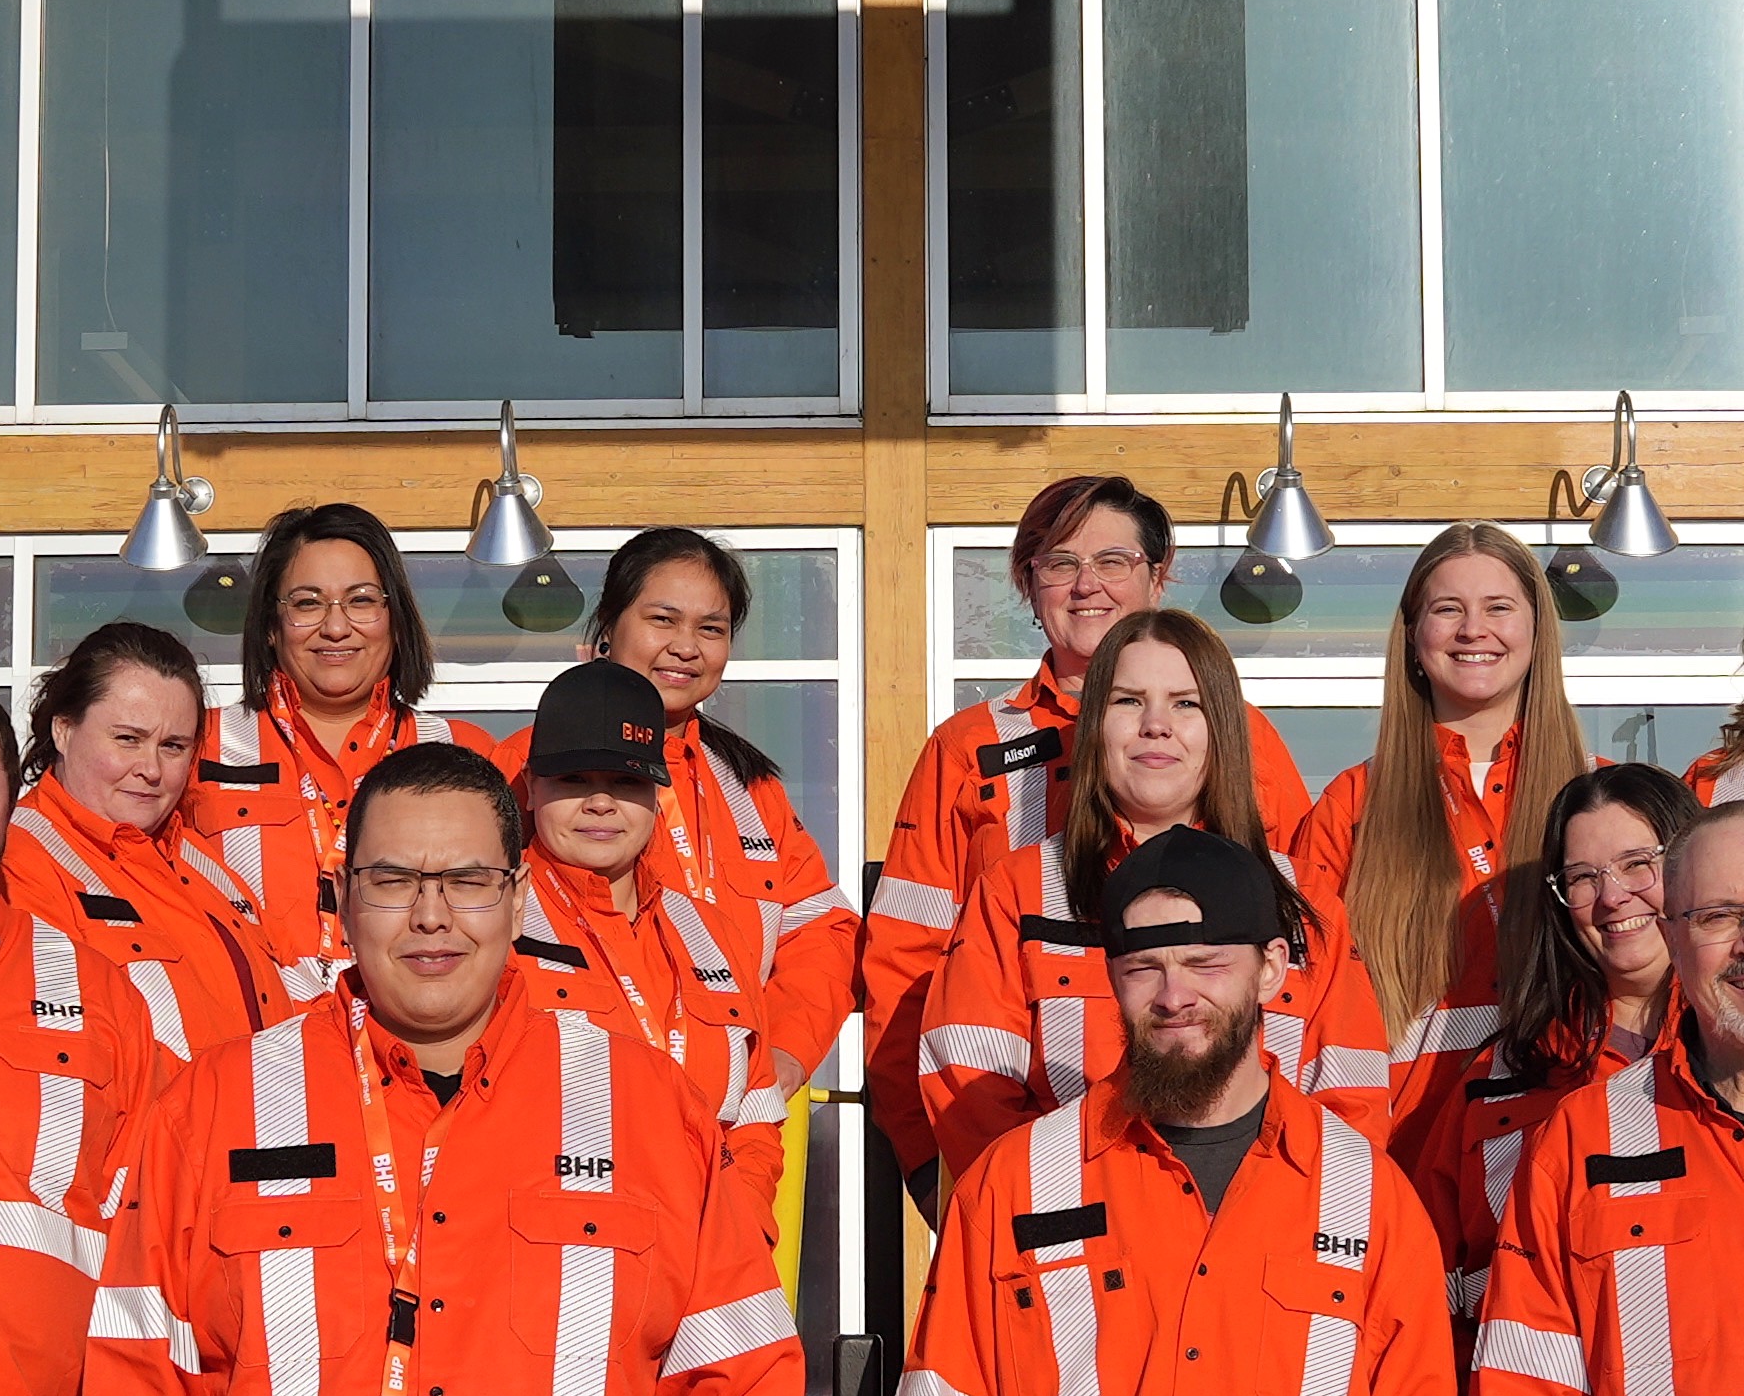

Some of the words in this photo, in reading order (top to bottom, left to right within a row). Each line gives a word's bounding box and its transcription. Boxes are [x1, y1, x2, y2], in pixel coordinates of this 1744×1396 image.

[622, 722, 654, 745] BHP
[1004, 744, 1037, 765] Alison
[299, 772, 317, 801] BHP
[670, 825, 692, 858] BHP
[739, 835, 776, 852] BHP
[1468, 845, 1492, 875] BHP
[690, 967, 733, 983] BHP
[619, 975, 645, 1007] BHP
[30, 1000, 85, 1018] BHP
[372, 1152, 397, 1194] BHP
[421, 1146, 440, 1188] BHP
[554, 1154, 615, 1179] BHP
[380, 1205, 393, 1232] Team
[1312, 1231, 1369, 1258] BHP
[388, 1355, 405, 1391] BHP
